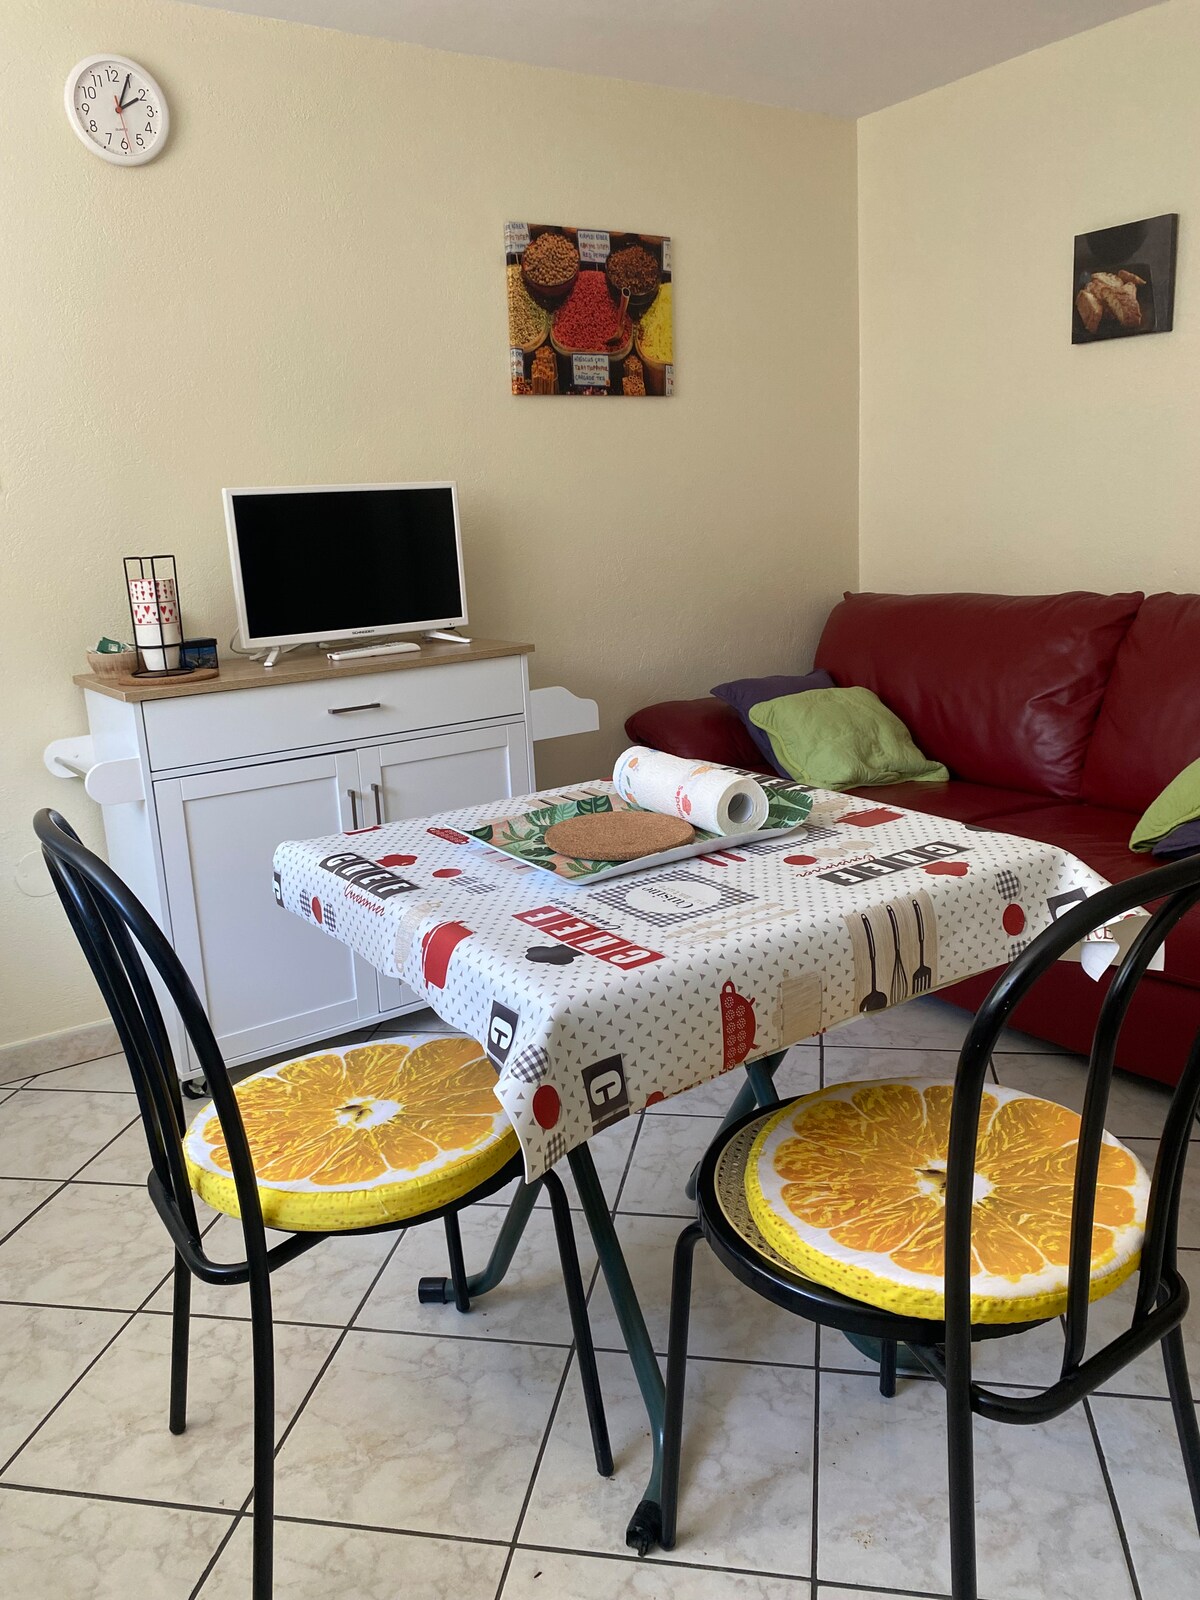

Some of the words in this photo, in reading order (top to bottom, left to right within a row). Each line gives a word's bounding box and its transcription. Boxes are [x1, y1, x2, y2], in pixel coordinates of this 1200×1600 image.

[91, 74, 103, 87] 11
[105, 69, 120, 83] 12
[82, 86, 97, 99] 10
[138, 88, 147, 101] 2
[81, 103, 90, 115] 9
[146, 105, 155, 118] 3
[89, 119, 98, 133] 8
[144, 121, 153, 134] 4
[105, 132, 113, 145] 7
[120, 137, 129, 150] 6
[135, 133, 144, 146] 5
[835, 843, 960, 884] CHEF
[325, 853, 415, 896] CHEF
[523, 909, 652, 964] CHEF
